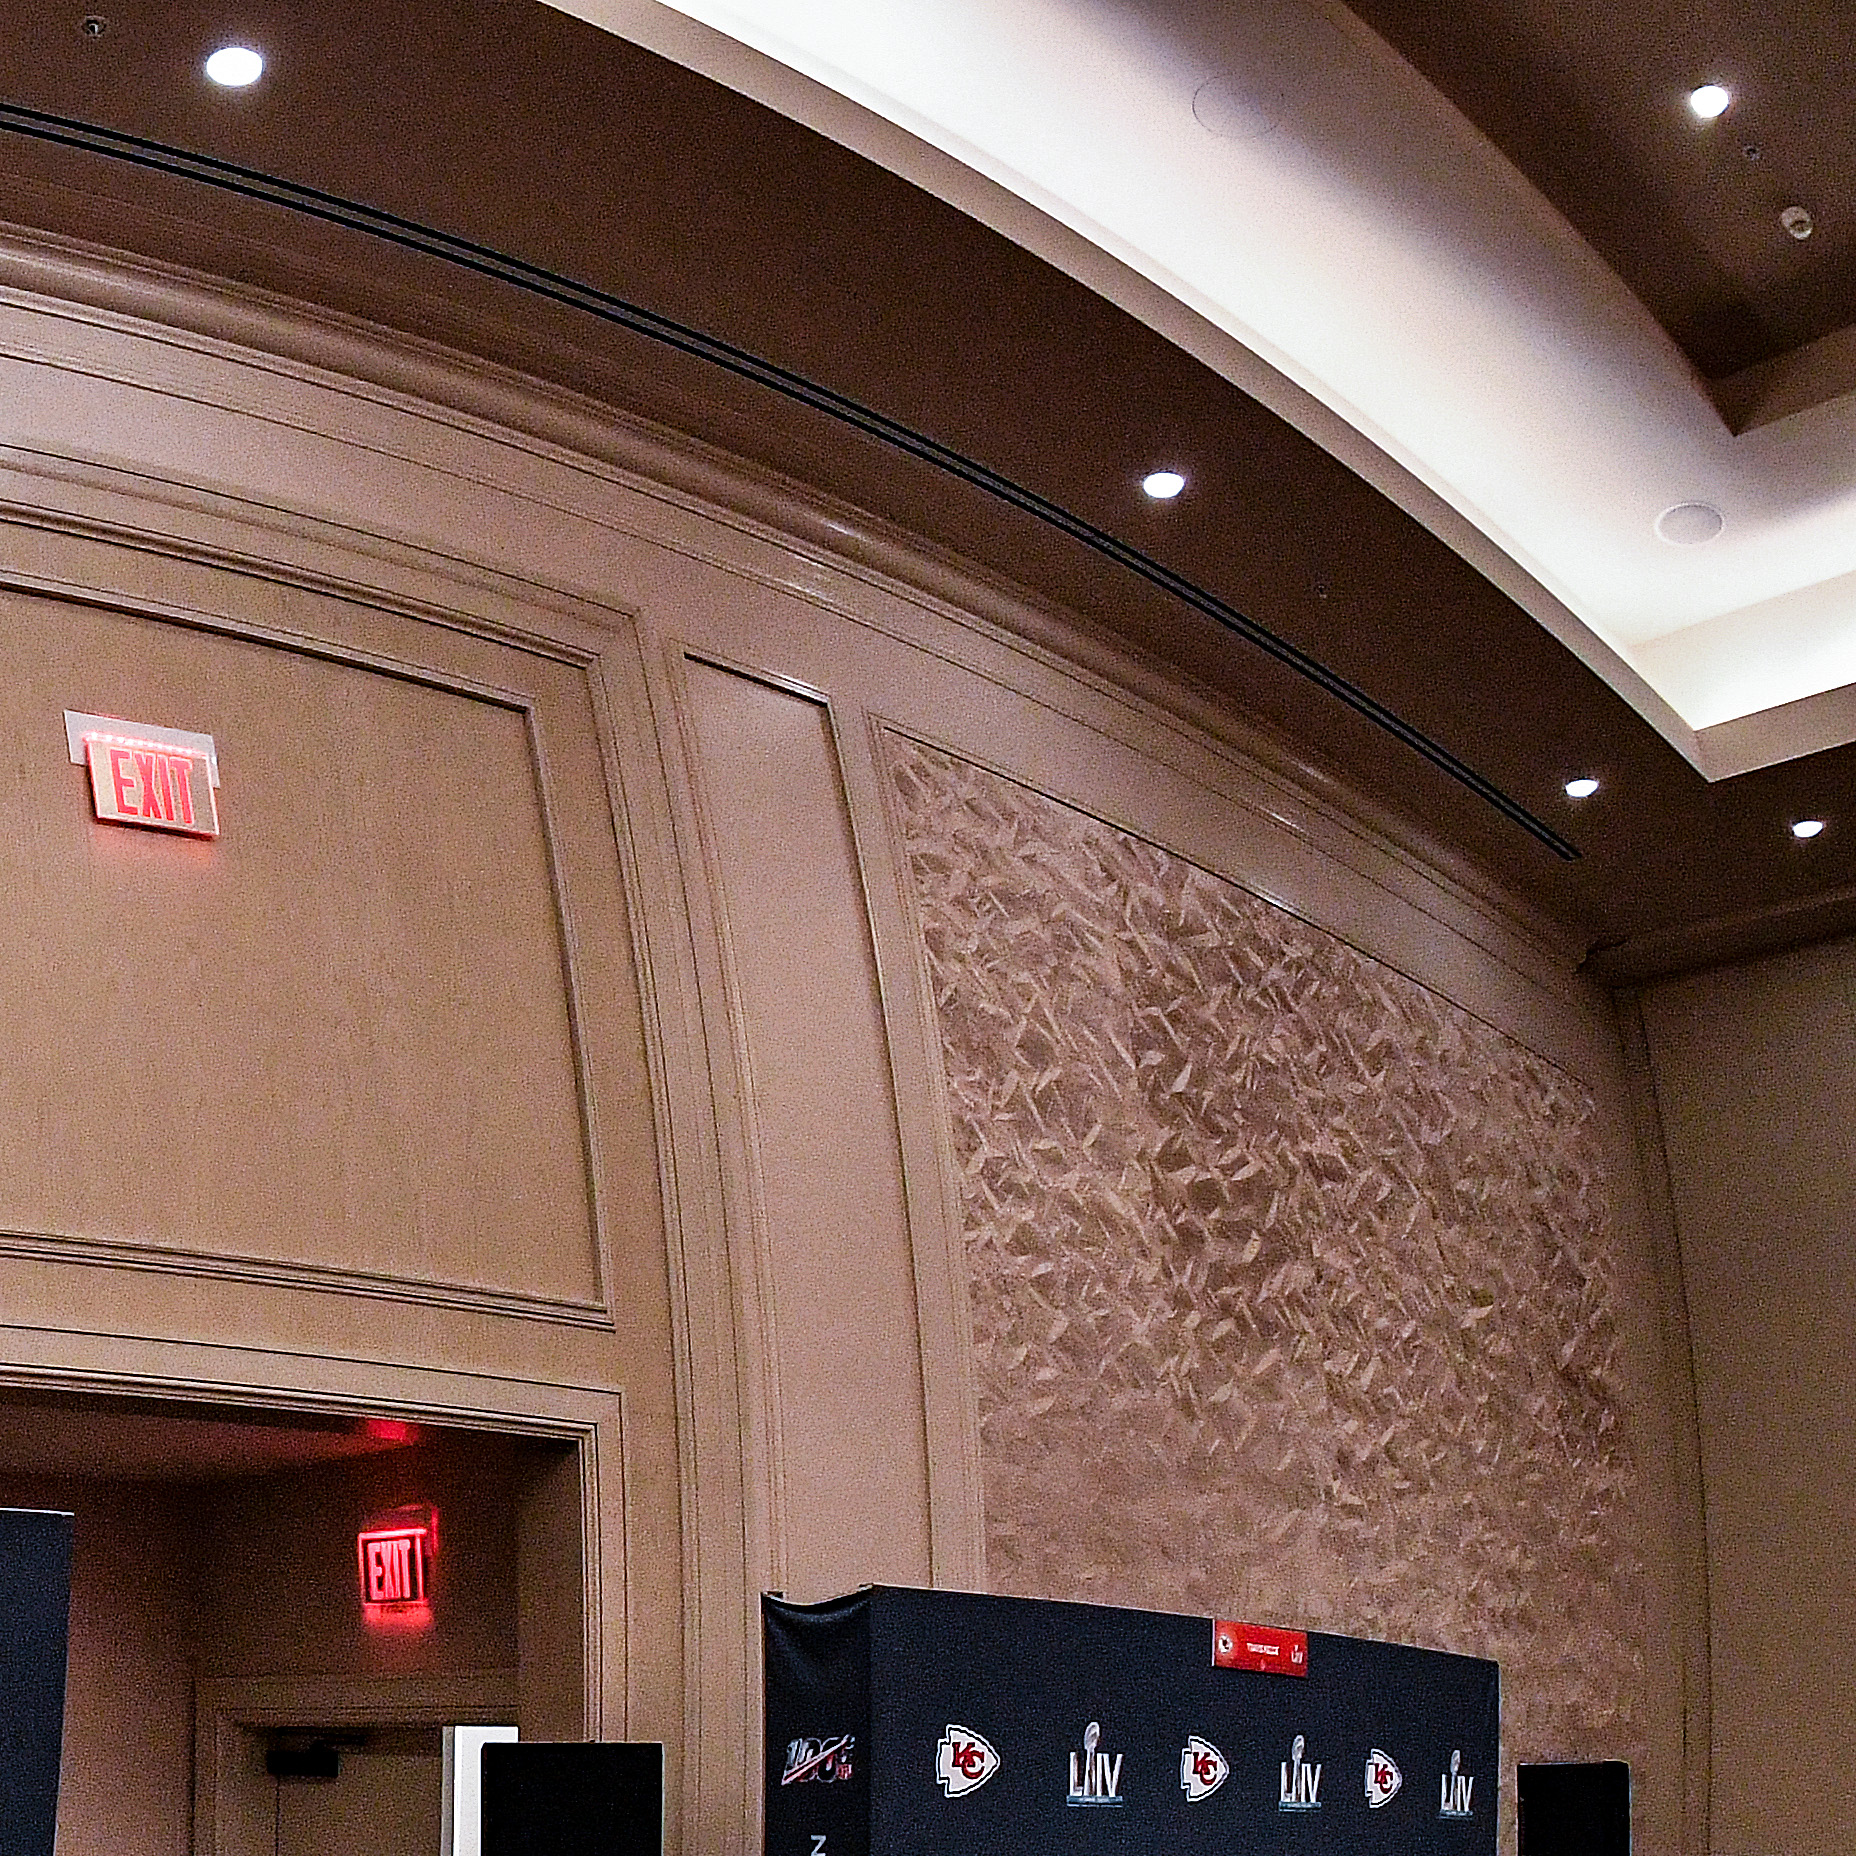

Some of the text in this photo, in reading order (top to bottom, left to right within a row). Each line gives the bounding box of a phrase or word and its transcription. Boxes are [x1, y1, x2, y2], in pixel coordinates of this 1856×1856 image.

[109, 748, 194, 824] EXIT
[367, 1539, 411, 1600] EXIT
[952, 1742, 984, 1779] KC
[1070, 1752, 1123, 1796] LIV
[1192, 1752, 1217, 1785] KC
[1280, 1762, 1321, 1803] LIV
